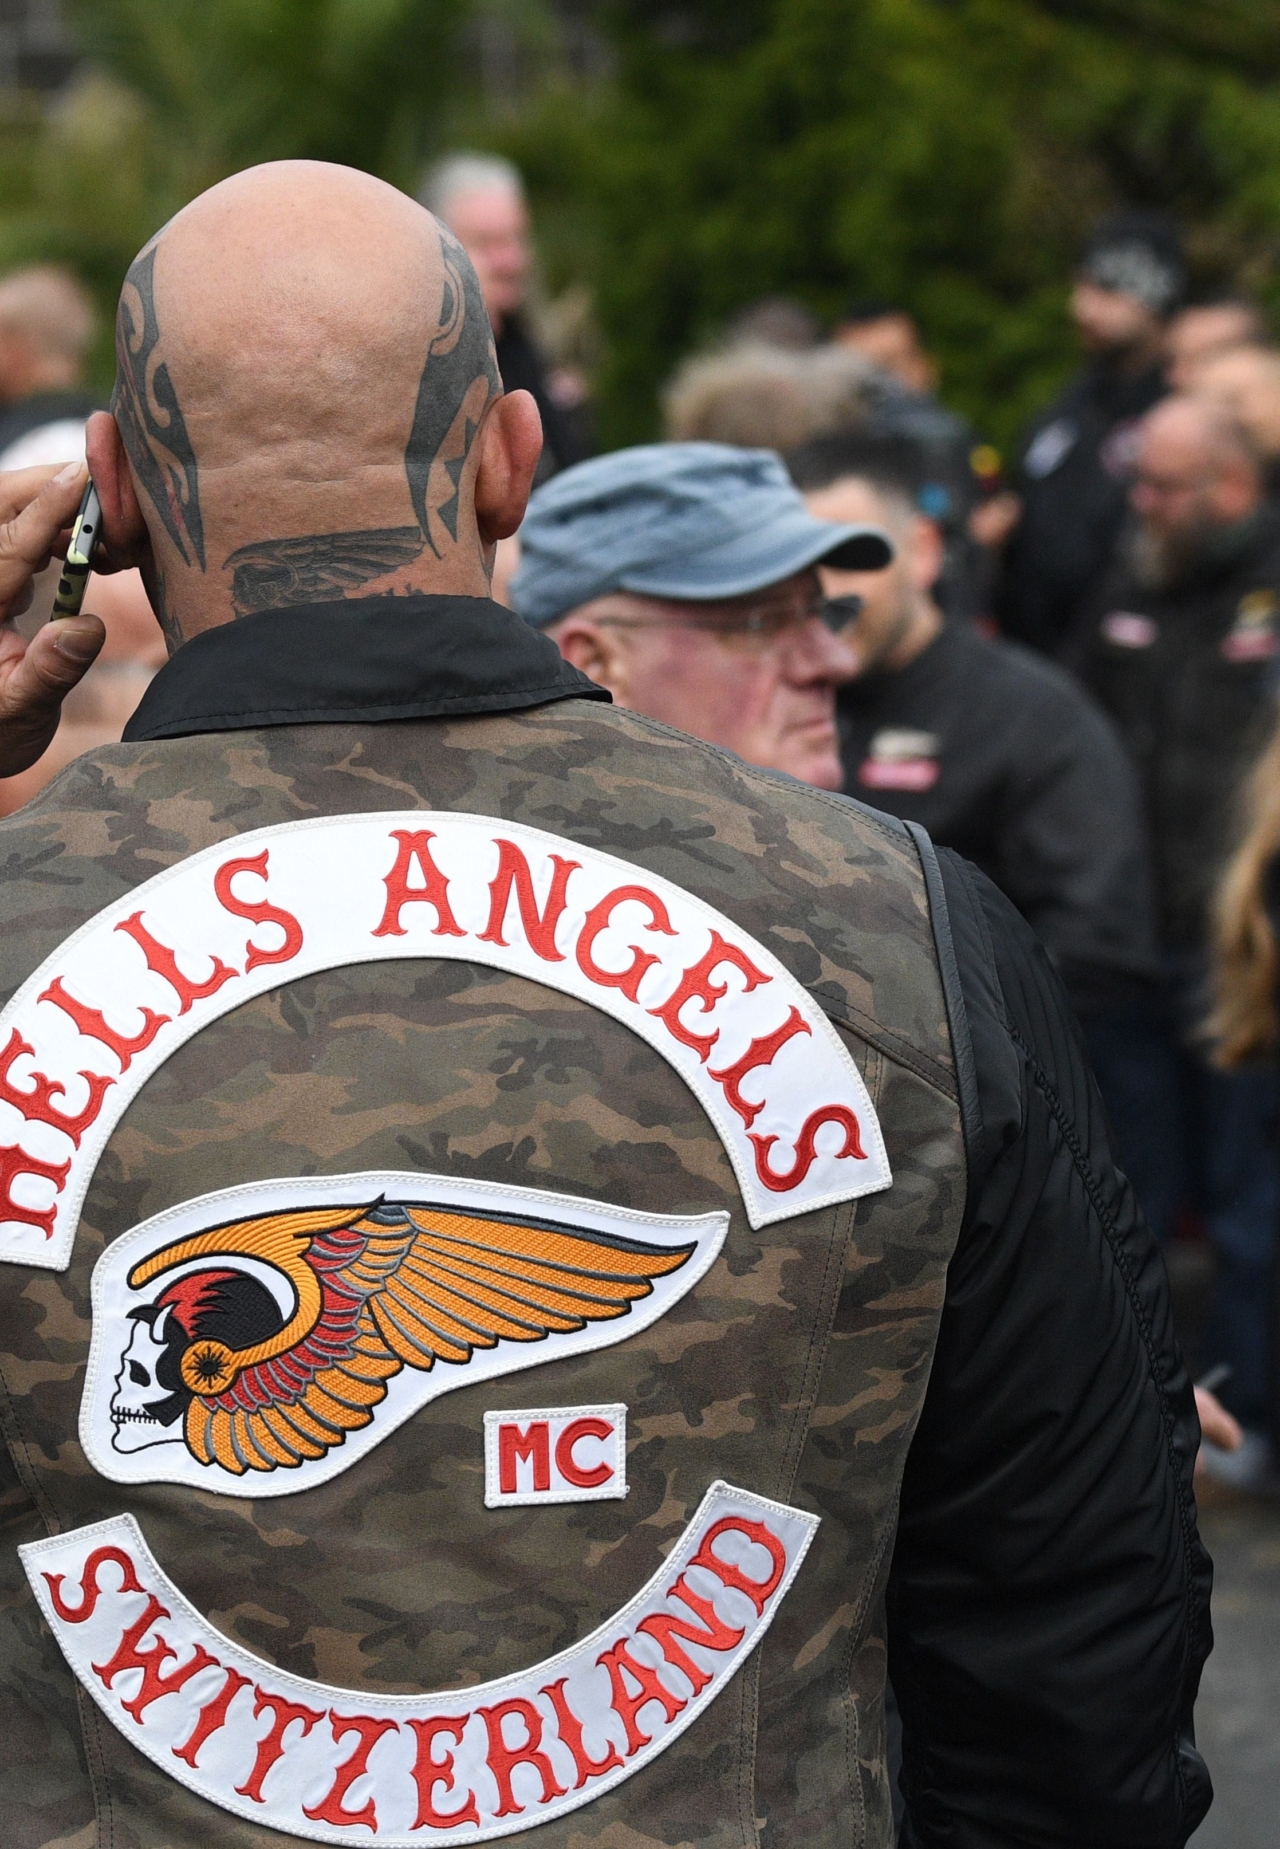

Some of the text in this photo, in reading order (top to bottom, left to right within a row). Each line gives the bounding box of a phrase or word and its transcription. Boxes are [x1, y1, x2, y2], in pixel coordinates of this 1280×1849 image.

[370, 828, 869, 1194] ANGELS
[497, 1415, 616, 1495] MC
[42, 1514, 788, 1834] SWITZERLAND
